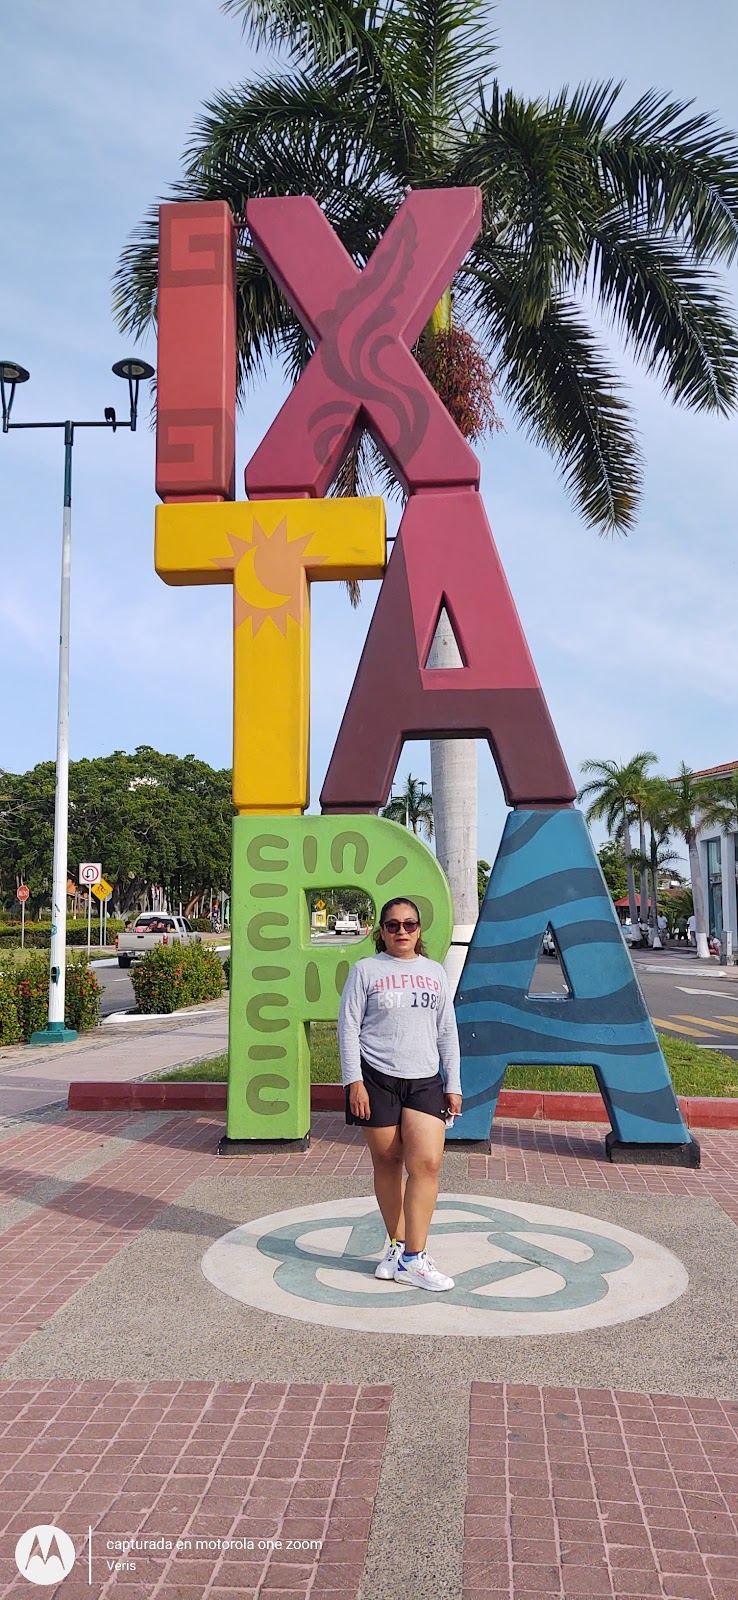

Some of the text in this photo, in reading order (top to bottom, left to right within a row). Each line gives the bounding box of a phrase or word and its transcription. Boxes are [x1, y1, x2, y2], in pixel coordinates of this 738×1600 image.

[155, 187, 483, 502] IX
[155, 491, 577, 815] TA
[227, 808, 693, 1145] PA
[374, 974, 440, 993] HILFIGER
[377, 991, 406, 1010] EST.
